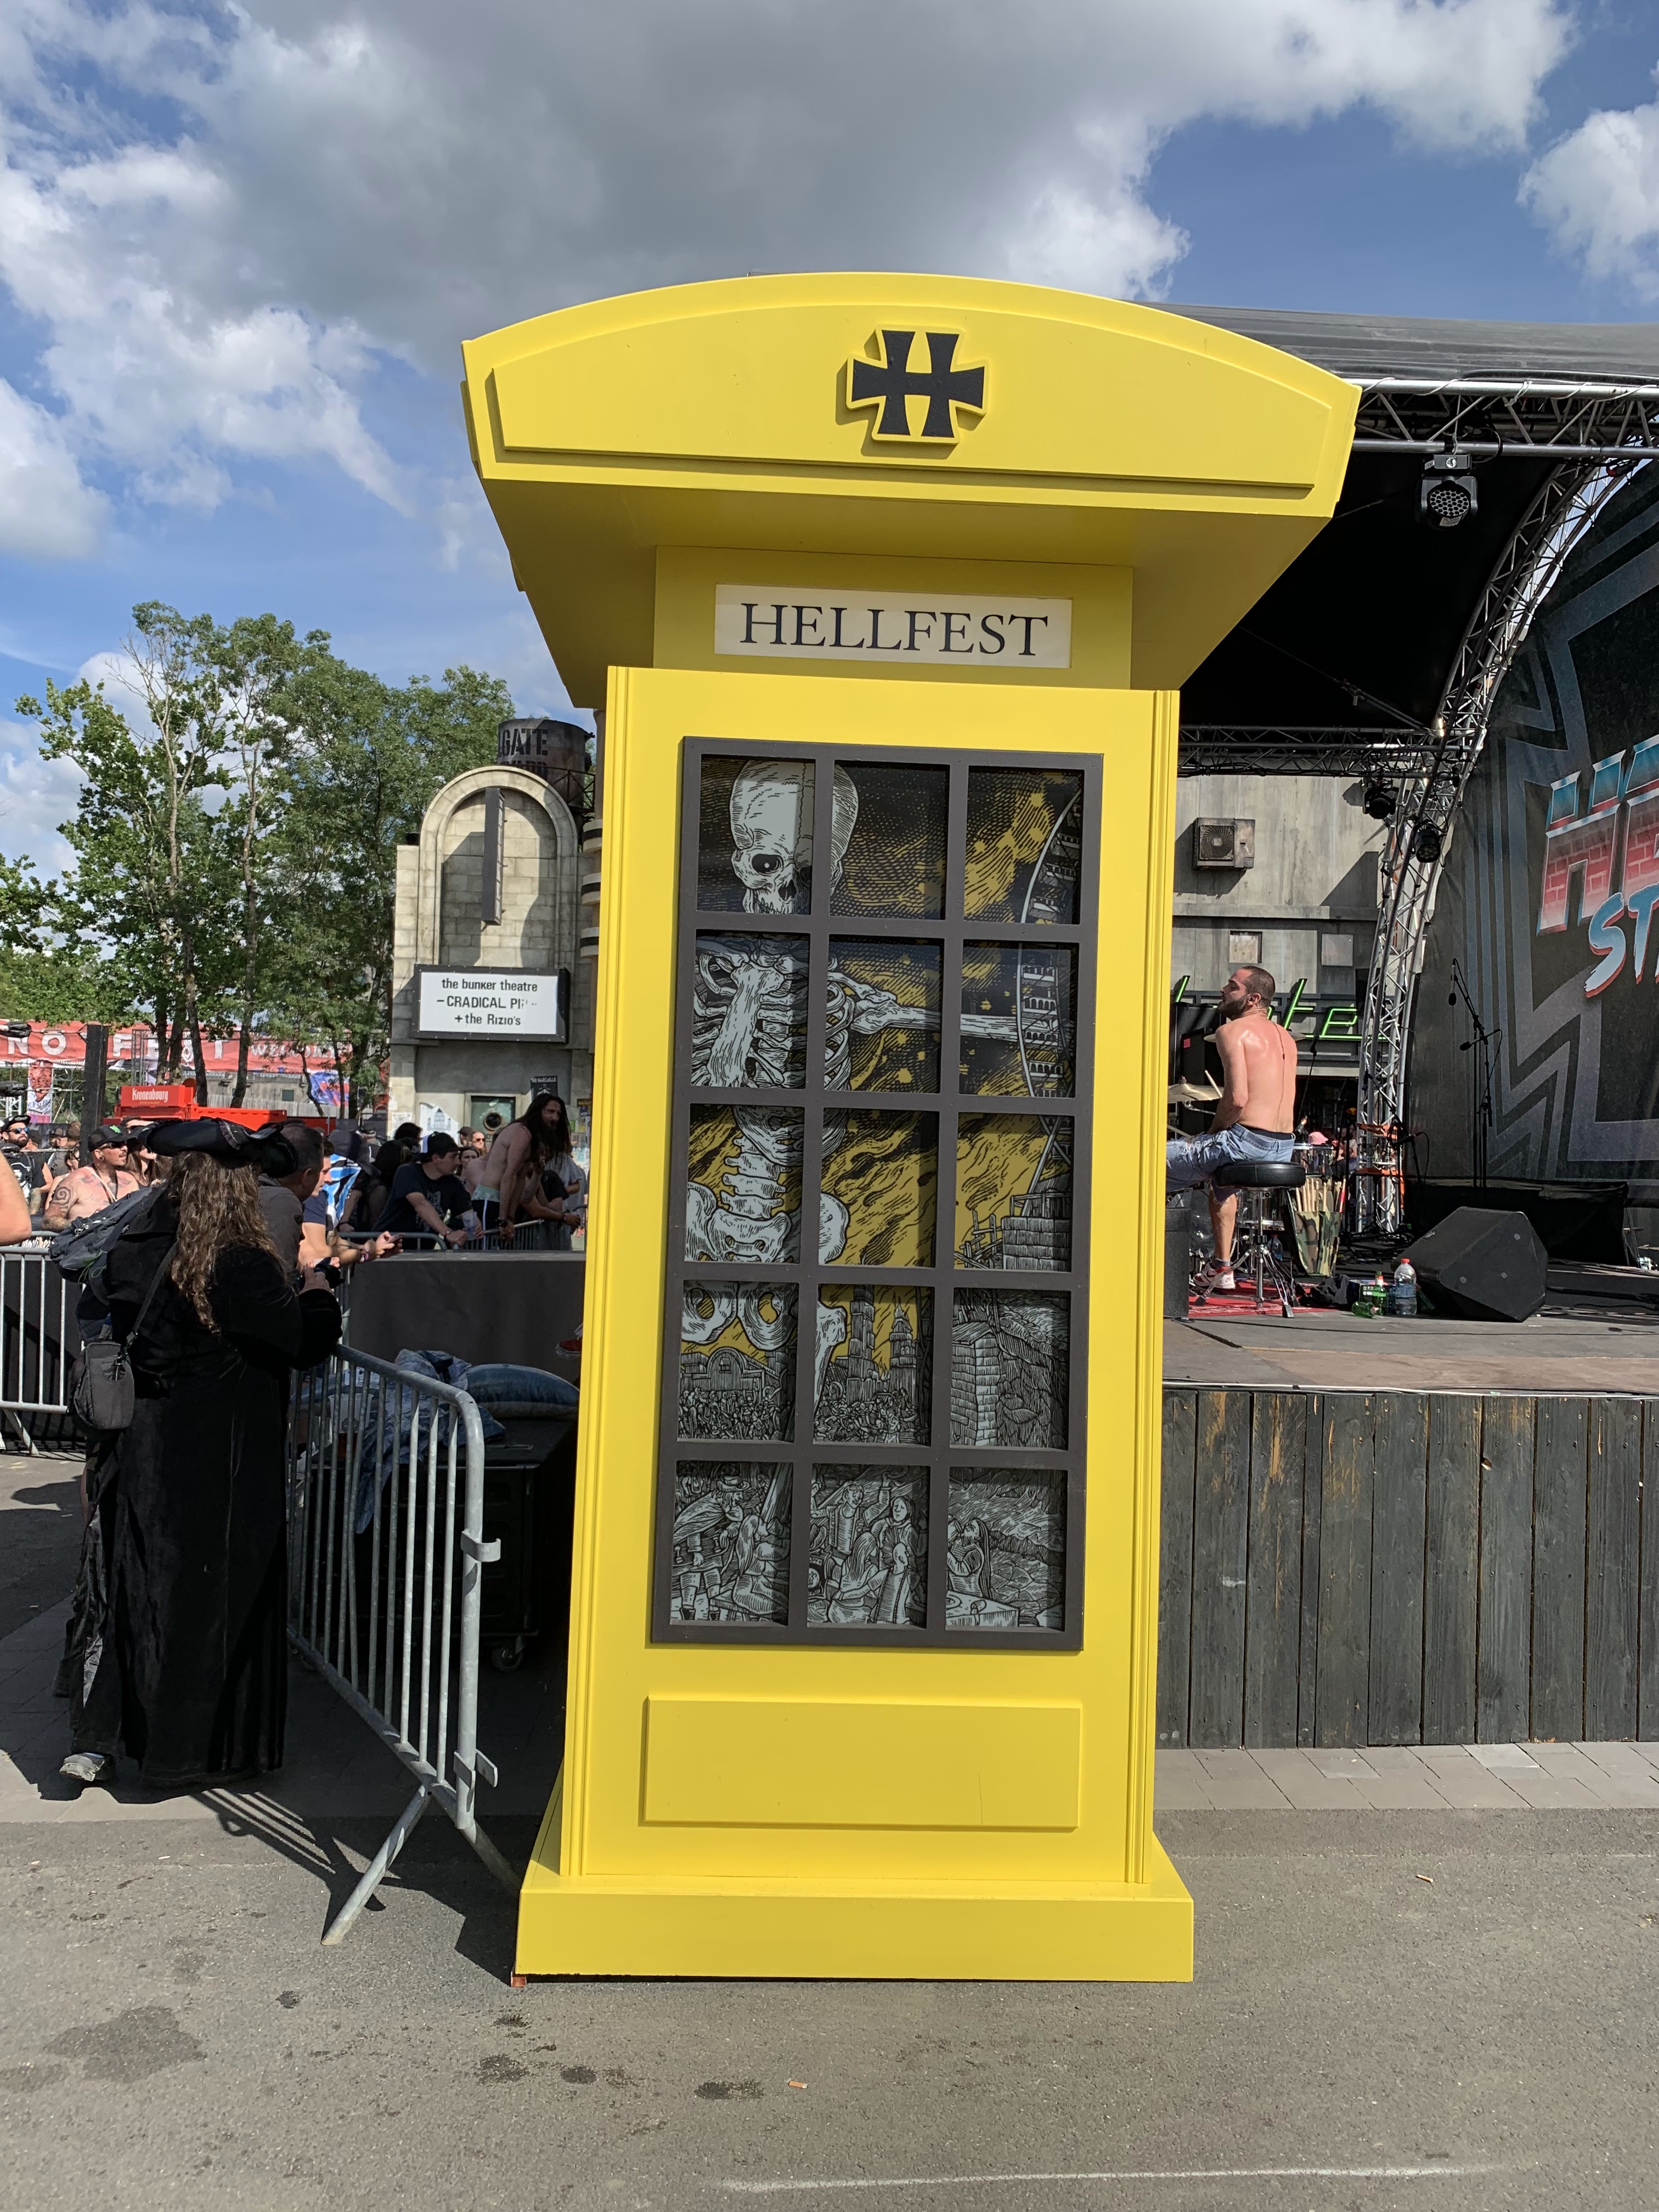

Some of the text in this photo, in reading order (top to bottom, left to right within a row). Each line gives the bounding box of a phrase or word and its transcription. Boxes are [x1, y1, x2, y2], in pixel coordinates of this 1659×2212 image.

[740, 602, 1048, 656] HELLFEST
[1584, 882, 1659, 998] ST
[442, 978, 538, 992] the bunker theatre
[132, 1087, 168, 1103] Kronenbourg
